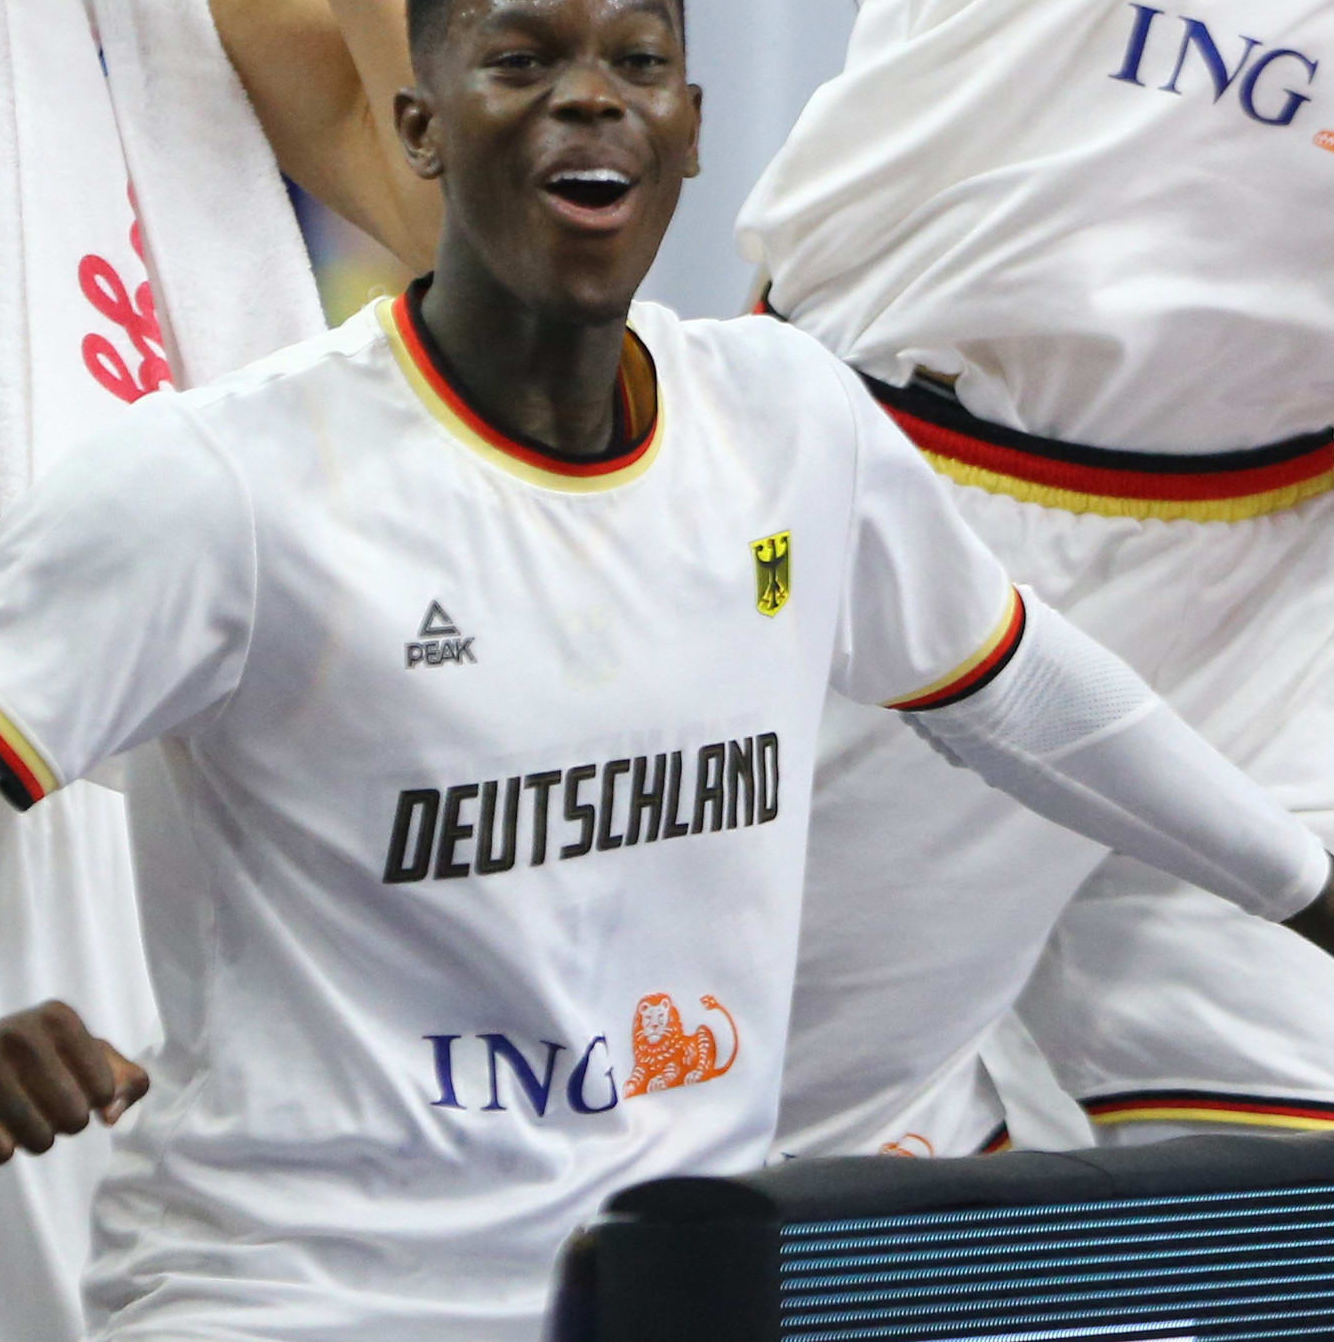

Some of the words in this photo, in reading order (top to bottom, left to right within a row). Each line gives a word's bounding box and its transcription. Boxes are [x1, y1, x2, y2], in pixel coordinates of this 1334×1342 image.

[1109, 2, 1319, 128] ING
[404, 637, 477, 670] PEAK
[382, 730, 780, 886] DEUTSCHLAND
[421, 1032, 620, 1119] ING
